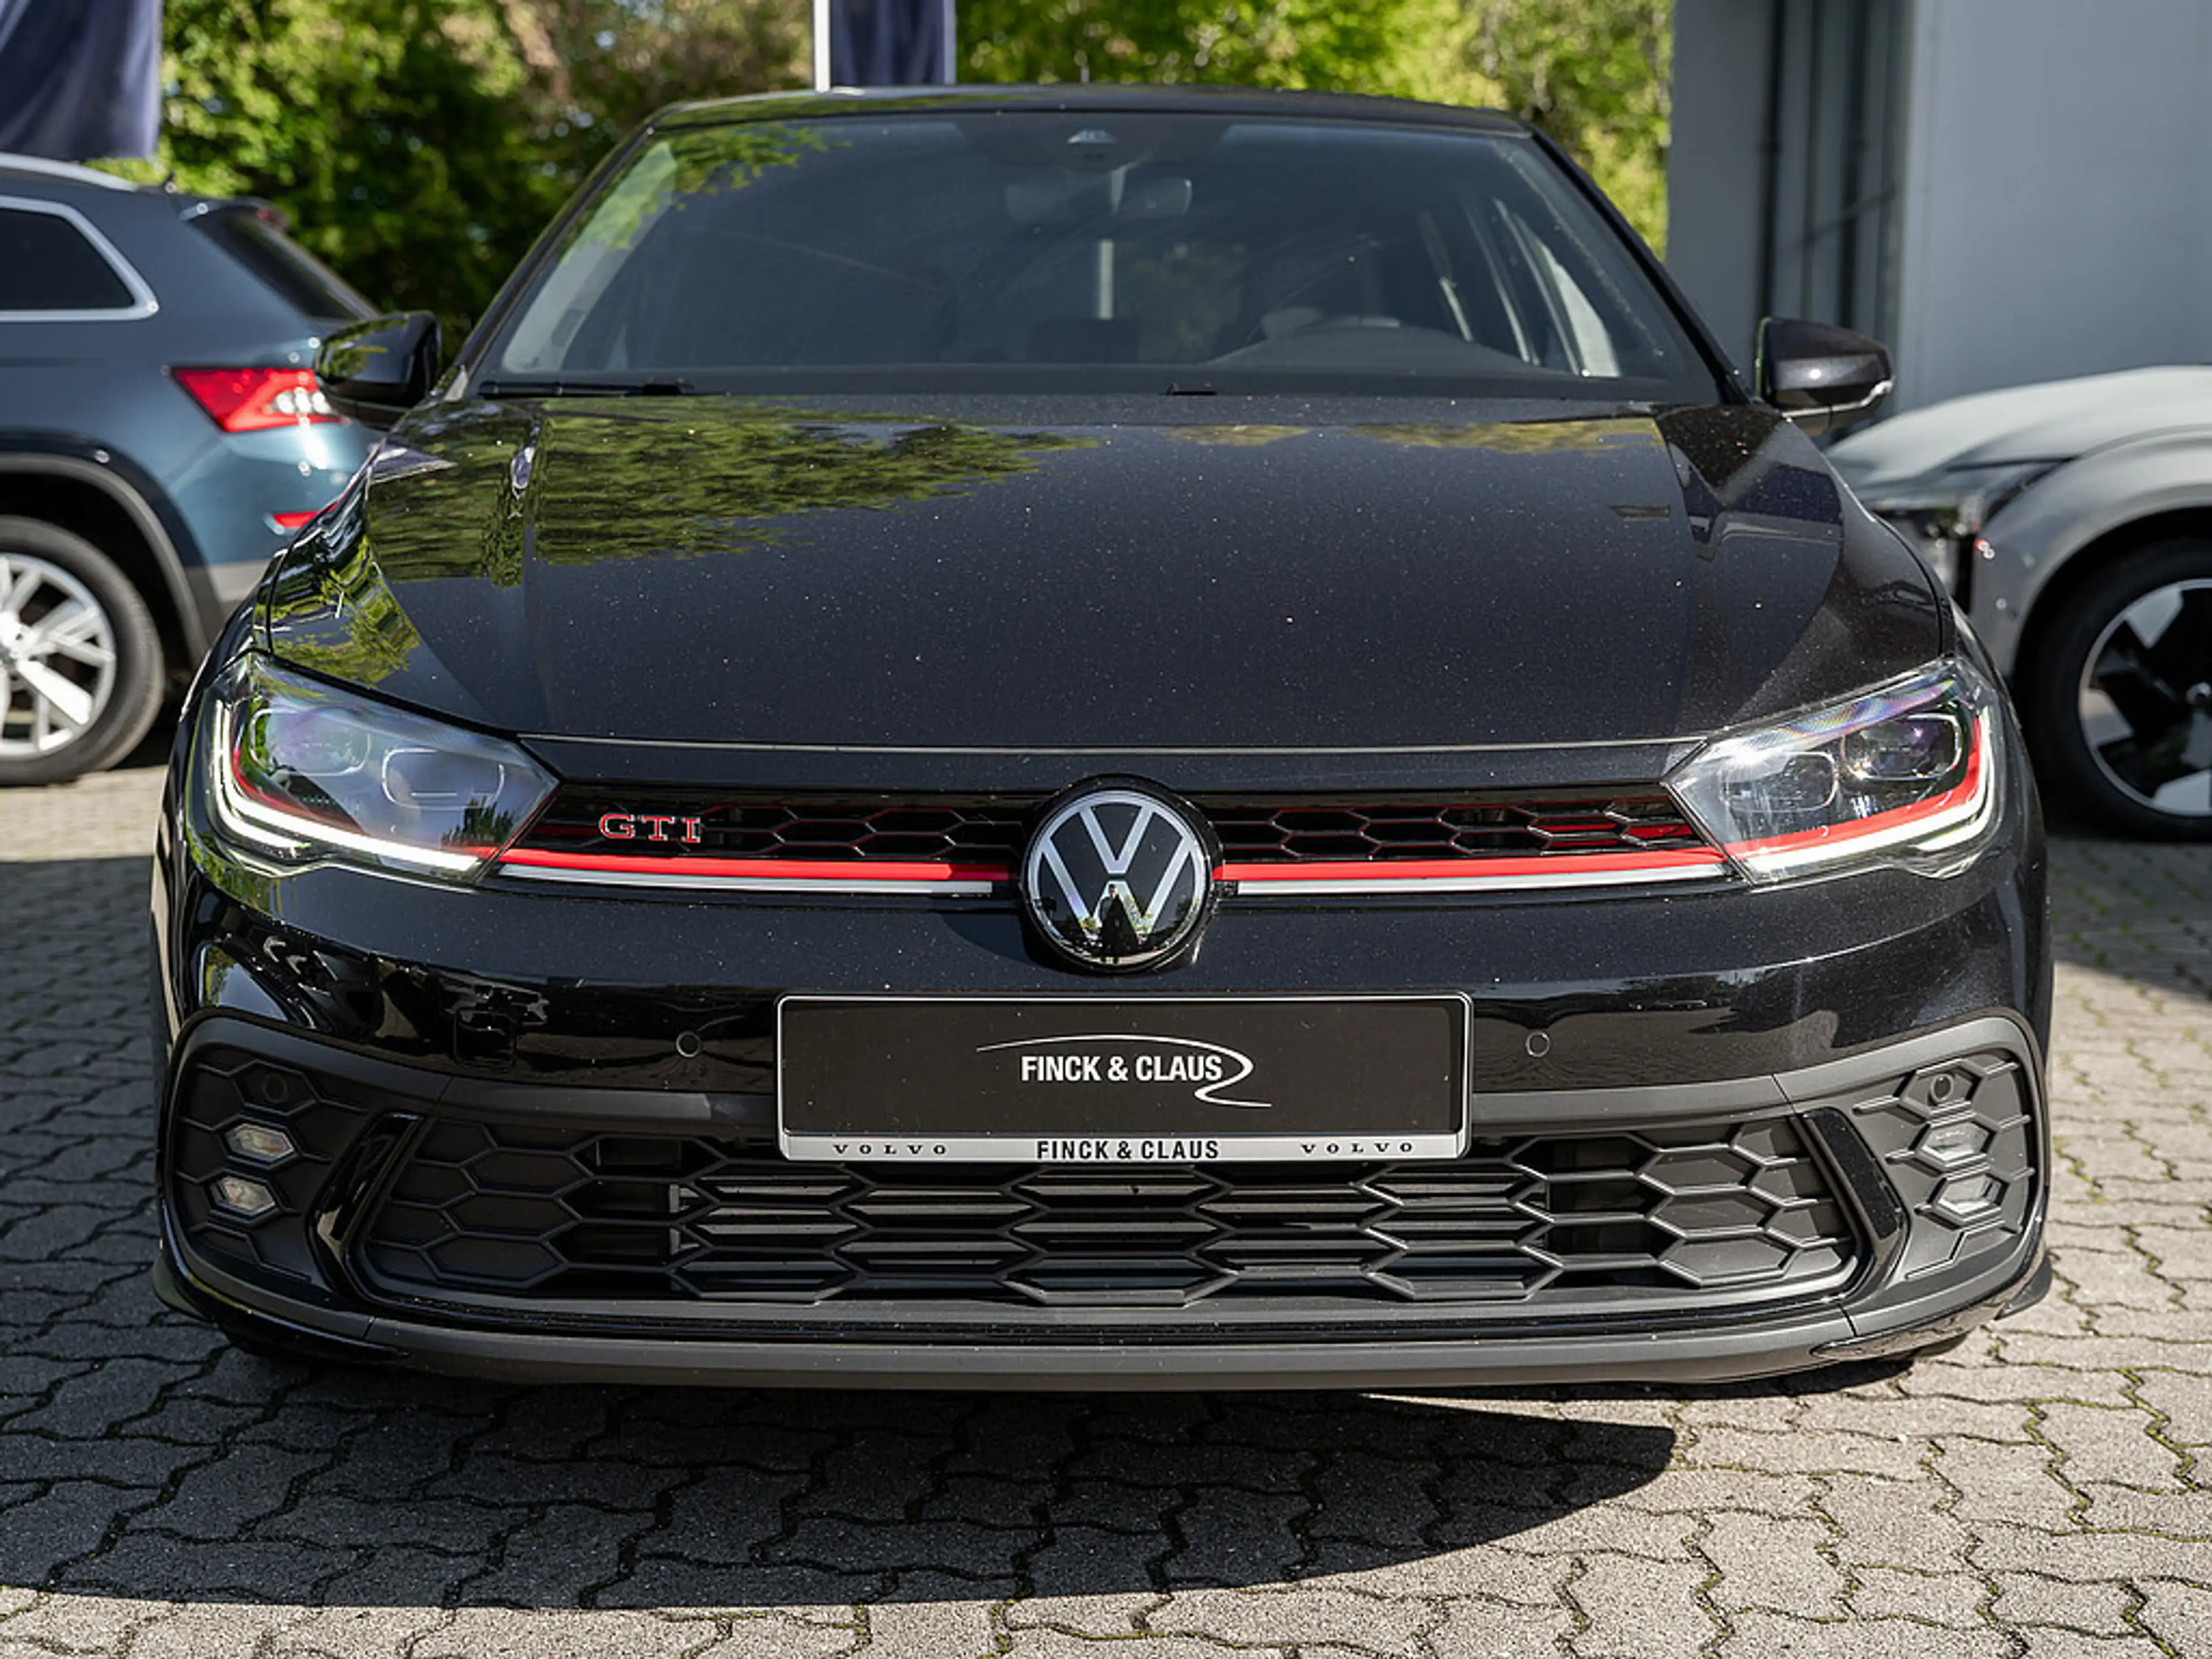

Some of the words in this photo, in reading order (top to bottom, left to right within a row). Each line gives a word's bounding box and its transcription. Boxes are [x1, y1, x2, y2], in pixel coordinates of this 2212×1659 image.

[599, 813, 701, 843] GTI
[1021, 1055, 1101, 1081] FINCK
[1107, 1055, 1129, 1081] &
[1135, 1055, 1222, 1081] CLAUS
[832, 1144, 946, 1154] VOLVO
[1036, 1140, 1109, 1160] FINCK
[1116, 1140, 1133, 1160] &
[1140, 1140, 1219, 1160] CLAUS
[1300, 1142, 1414, 1154] VOLVO
